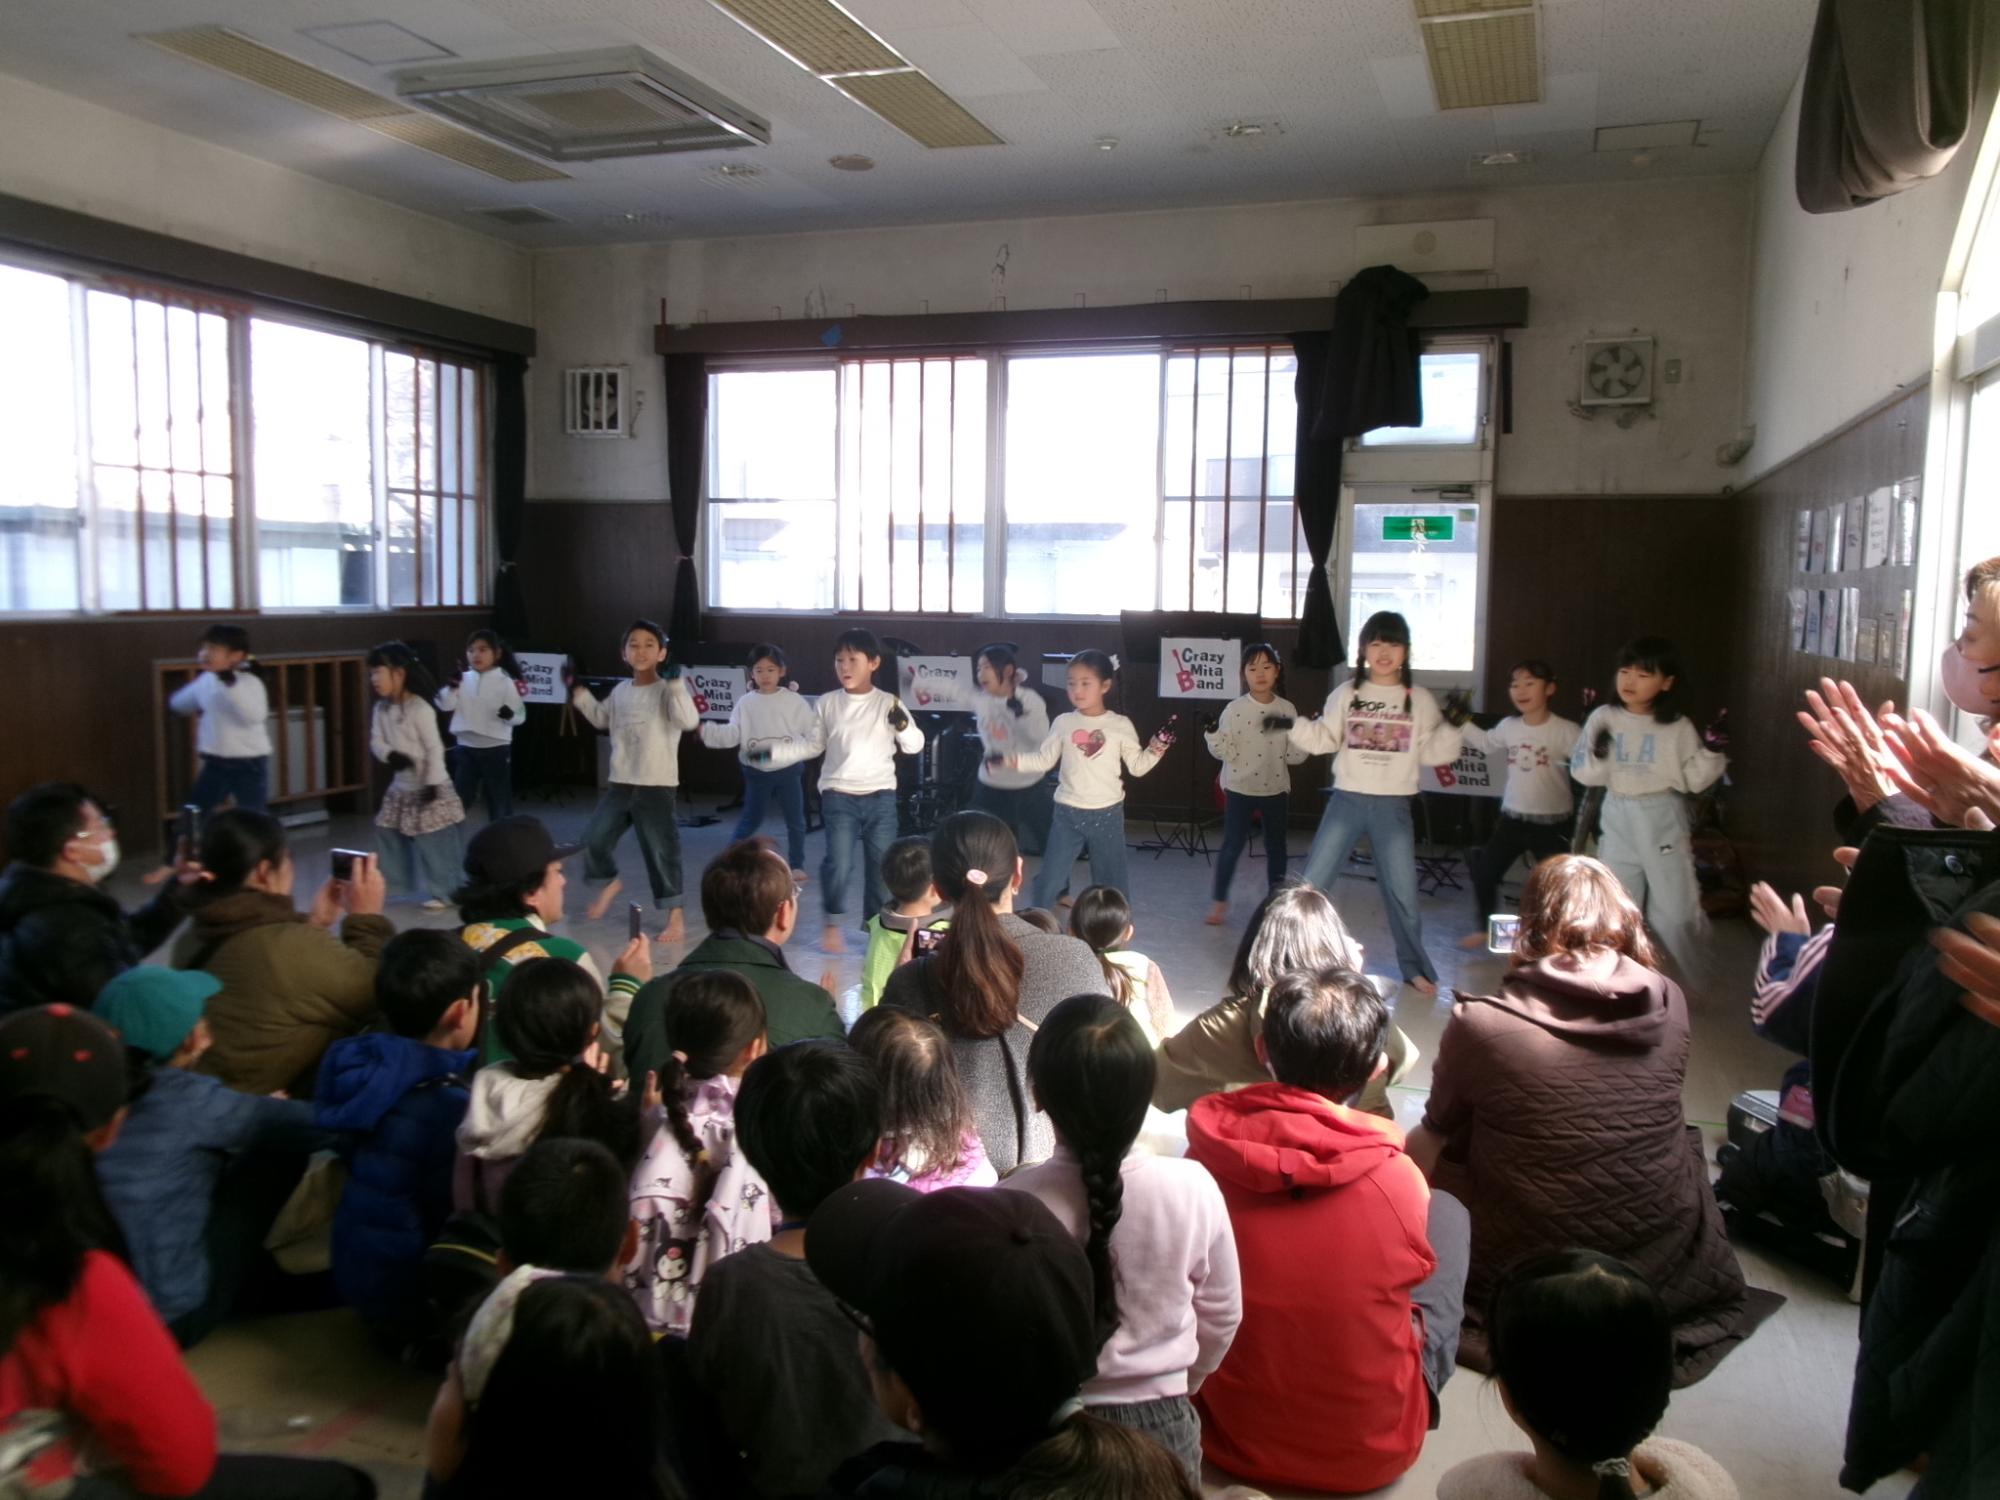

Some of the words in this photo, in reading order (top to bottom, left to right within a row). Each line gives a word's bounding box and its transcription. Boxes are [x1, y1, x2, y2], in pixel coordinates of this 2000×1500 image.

[1182, 647, 1224, 664] Crazy
[520, 660, 553, 675] Crazy
[918, 664, 958, 680] Crazy
[1190, 664, 1223, 676] Mita
[514, 679, 553, 697] Band
[695, 675, 732, 690] Crazy
[1176, 670, 1224, 693] Band
[703, 689, 732, 700] Mita
[693, 694, 734, 714] Band
[1460, 746, 1486, 760] azy
[1450, 759, 1487, 773] Mita
[1433, 764, 1490, 787] Band
